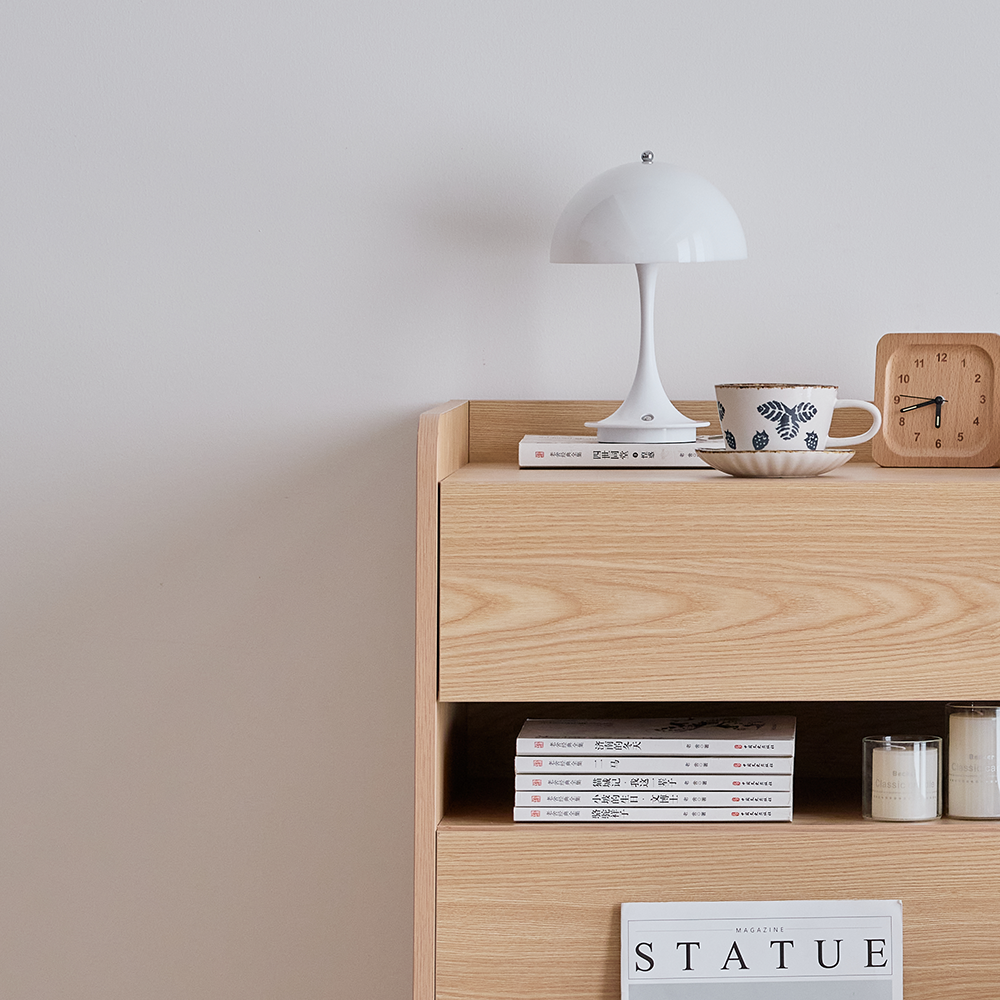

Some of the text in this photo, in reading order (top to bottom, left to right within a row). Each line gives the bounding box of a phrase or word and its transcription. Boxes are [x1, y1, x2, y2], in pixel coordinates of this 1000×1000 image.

[936, 353, 947, 362] 12
[914, 359, 924, 367] 11
[961, 359, 965, 367] 1
[898, 374, 909, 383] 10
[975, 374, 981, 383] 2
[893, 395, 900, 405] 9
[980, 395, 986, 404] 3
[899, 417, 905, 426] 8
[973, 417, 979, 426] 4
[914, 433, 920, 441] 7
[958, 433, 963, 441] 5
[936, 439, 941, 448] 6
[593, 450, 629, 460] 四世同堂
[594, 741, 642, 751] 济南的冬天
[875, 778, 906, 789] Classic
[591, 808, 630, 819] 骆驼祥子
[735, 926, 785, 934] MAGAZINE
[635, 938, 888, 973] STATUE
